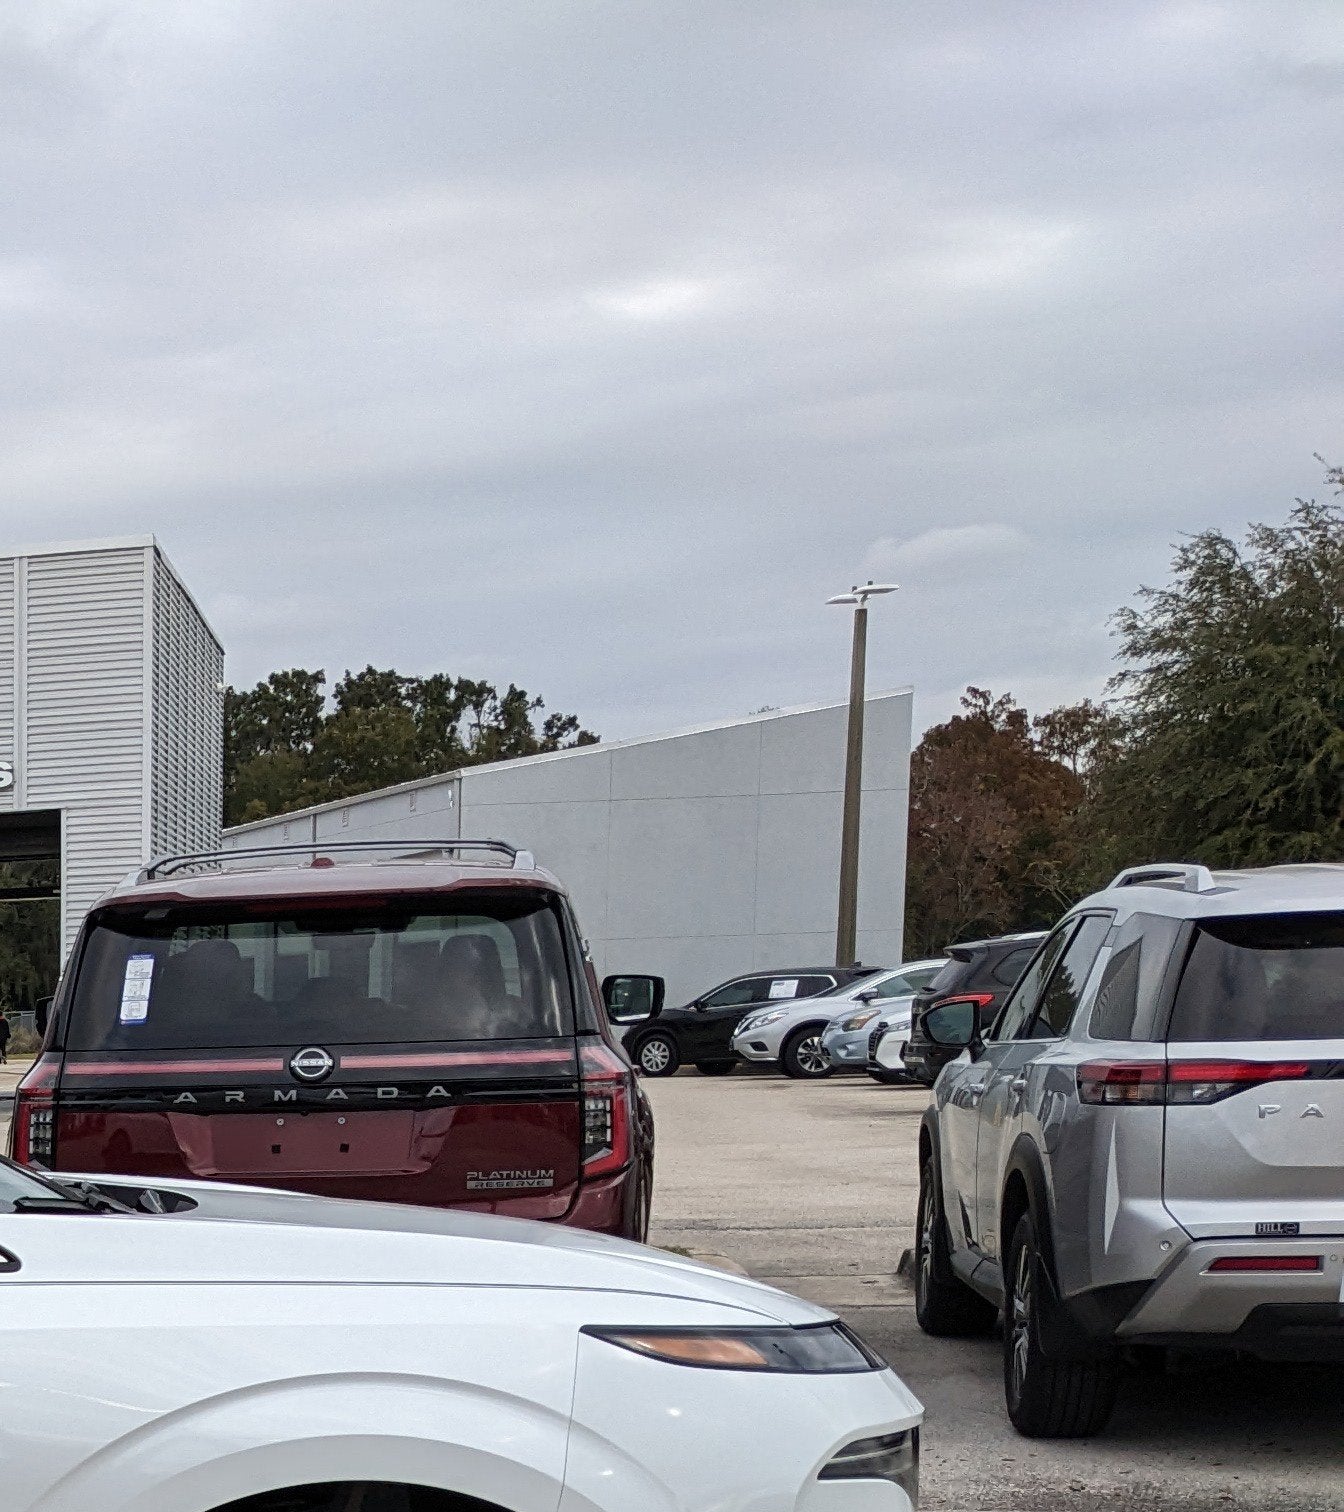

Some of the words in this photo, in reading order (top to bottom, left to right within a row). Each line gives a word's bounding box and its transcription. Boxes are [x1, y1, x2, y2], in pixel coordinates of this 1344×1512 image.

[172, 1085, 452, 1104] ARMADA
[466, 1169, 555, 1180] PLATINUM
[1257, 1222, 1283, 1233] HILL
